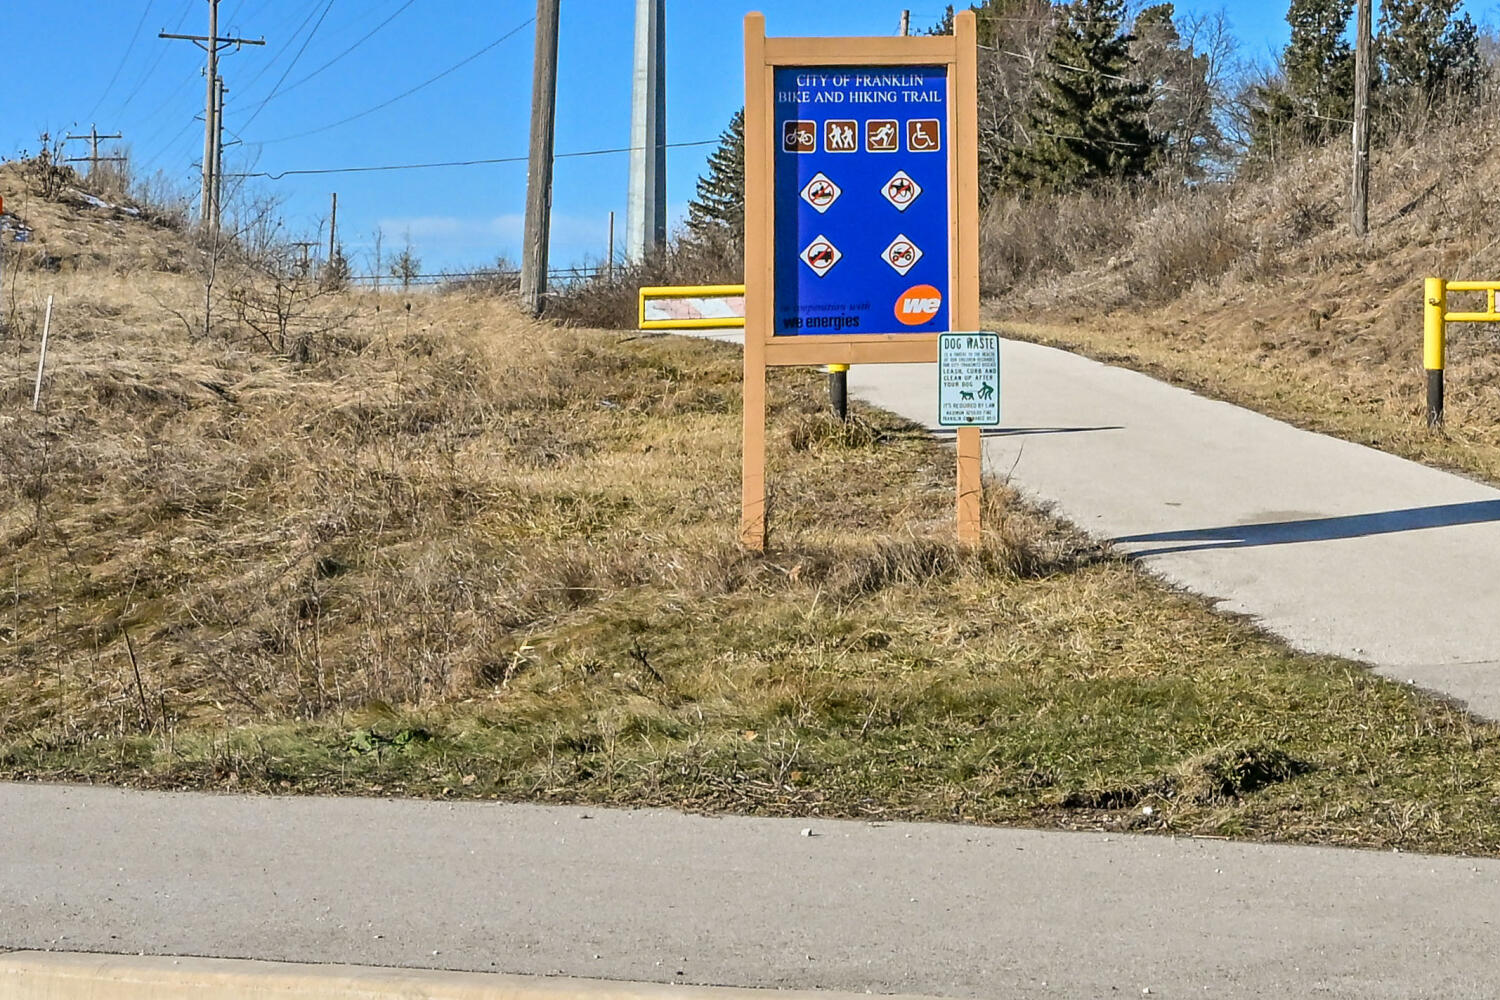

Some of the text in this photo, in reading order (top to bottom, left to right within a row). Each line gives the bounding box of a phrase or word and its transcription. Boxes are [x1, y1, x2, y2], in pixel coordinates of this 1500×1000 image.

[797, 73, 923, 87] CITY OF FRANKLIN
[778, 90, 941, 103] BIKE AND HIKING TRAIL
[806, 312, 860, 330] energies
[944, 337, 995, 349] DOG WASTE
